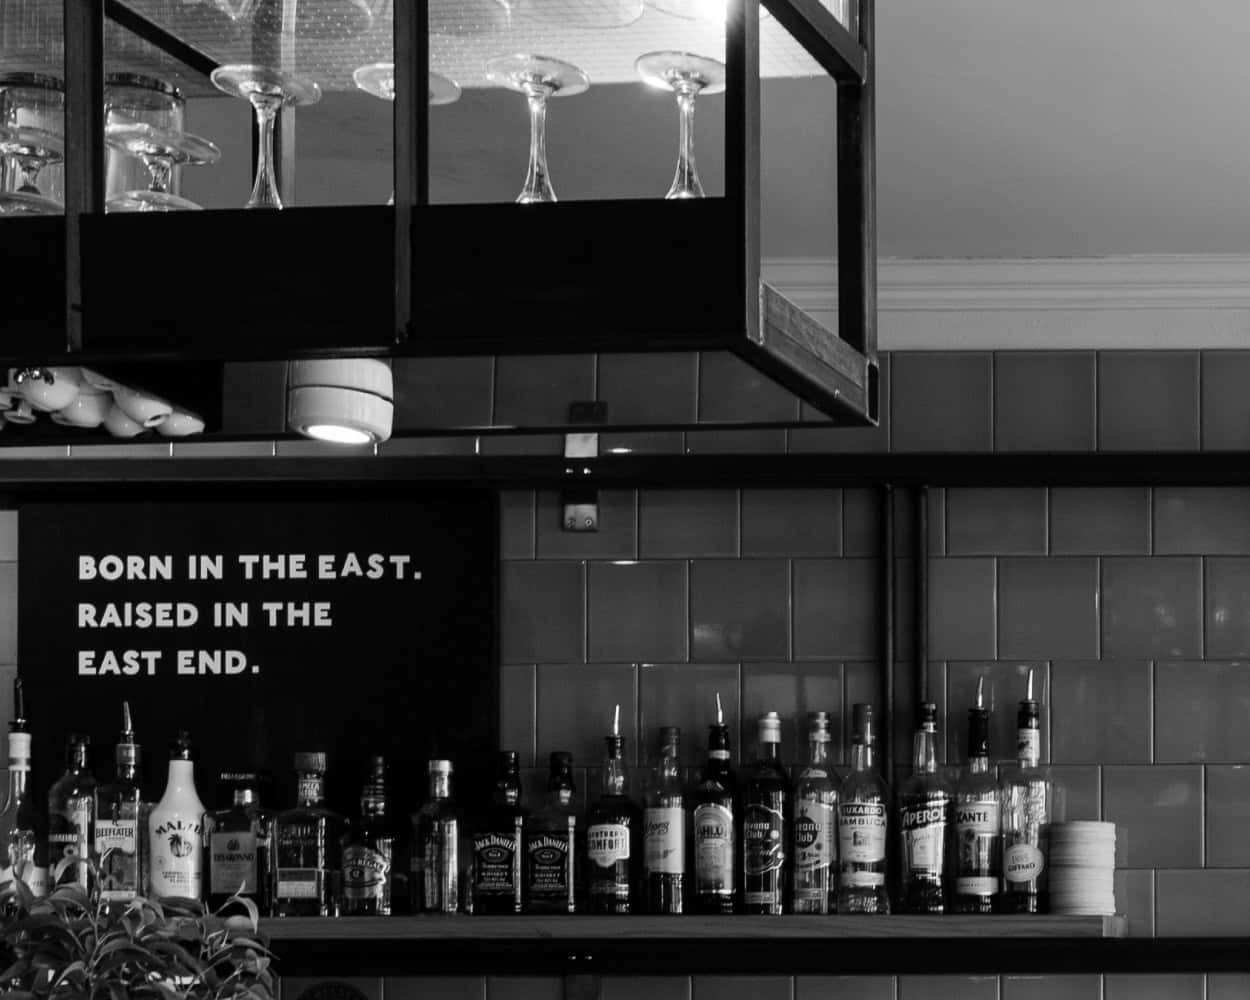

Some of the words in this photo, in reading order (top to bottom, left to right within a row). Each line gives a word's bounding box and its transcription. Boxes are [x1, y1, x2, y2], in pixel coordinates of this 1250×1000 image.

[78, 555, 173, 580] BORN
[188, 554, 224, 580] IN
[238, 554, 308, 580] THE
[318, 552, 422, 580] EAST.
[78, 602, 199, 628] RAISED
[213, 602, 249, 627] IN
[262, 602, 333, 627] THE
[78, 650, 162, 675] EAST
[177, 650, 260, 675] END.
[902, 807, 946, 826] APEROL
[95, 827, 134, 839] BEEFEATER
